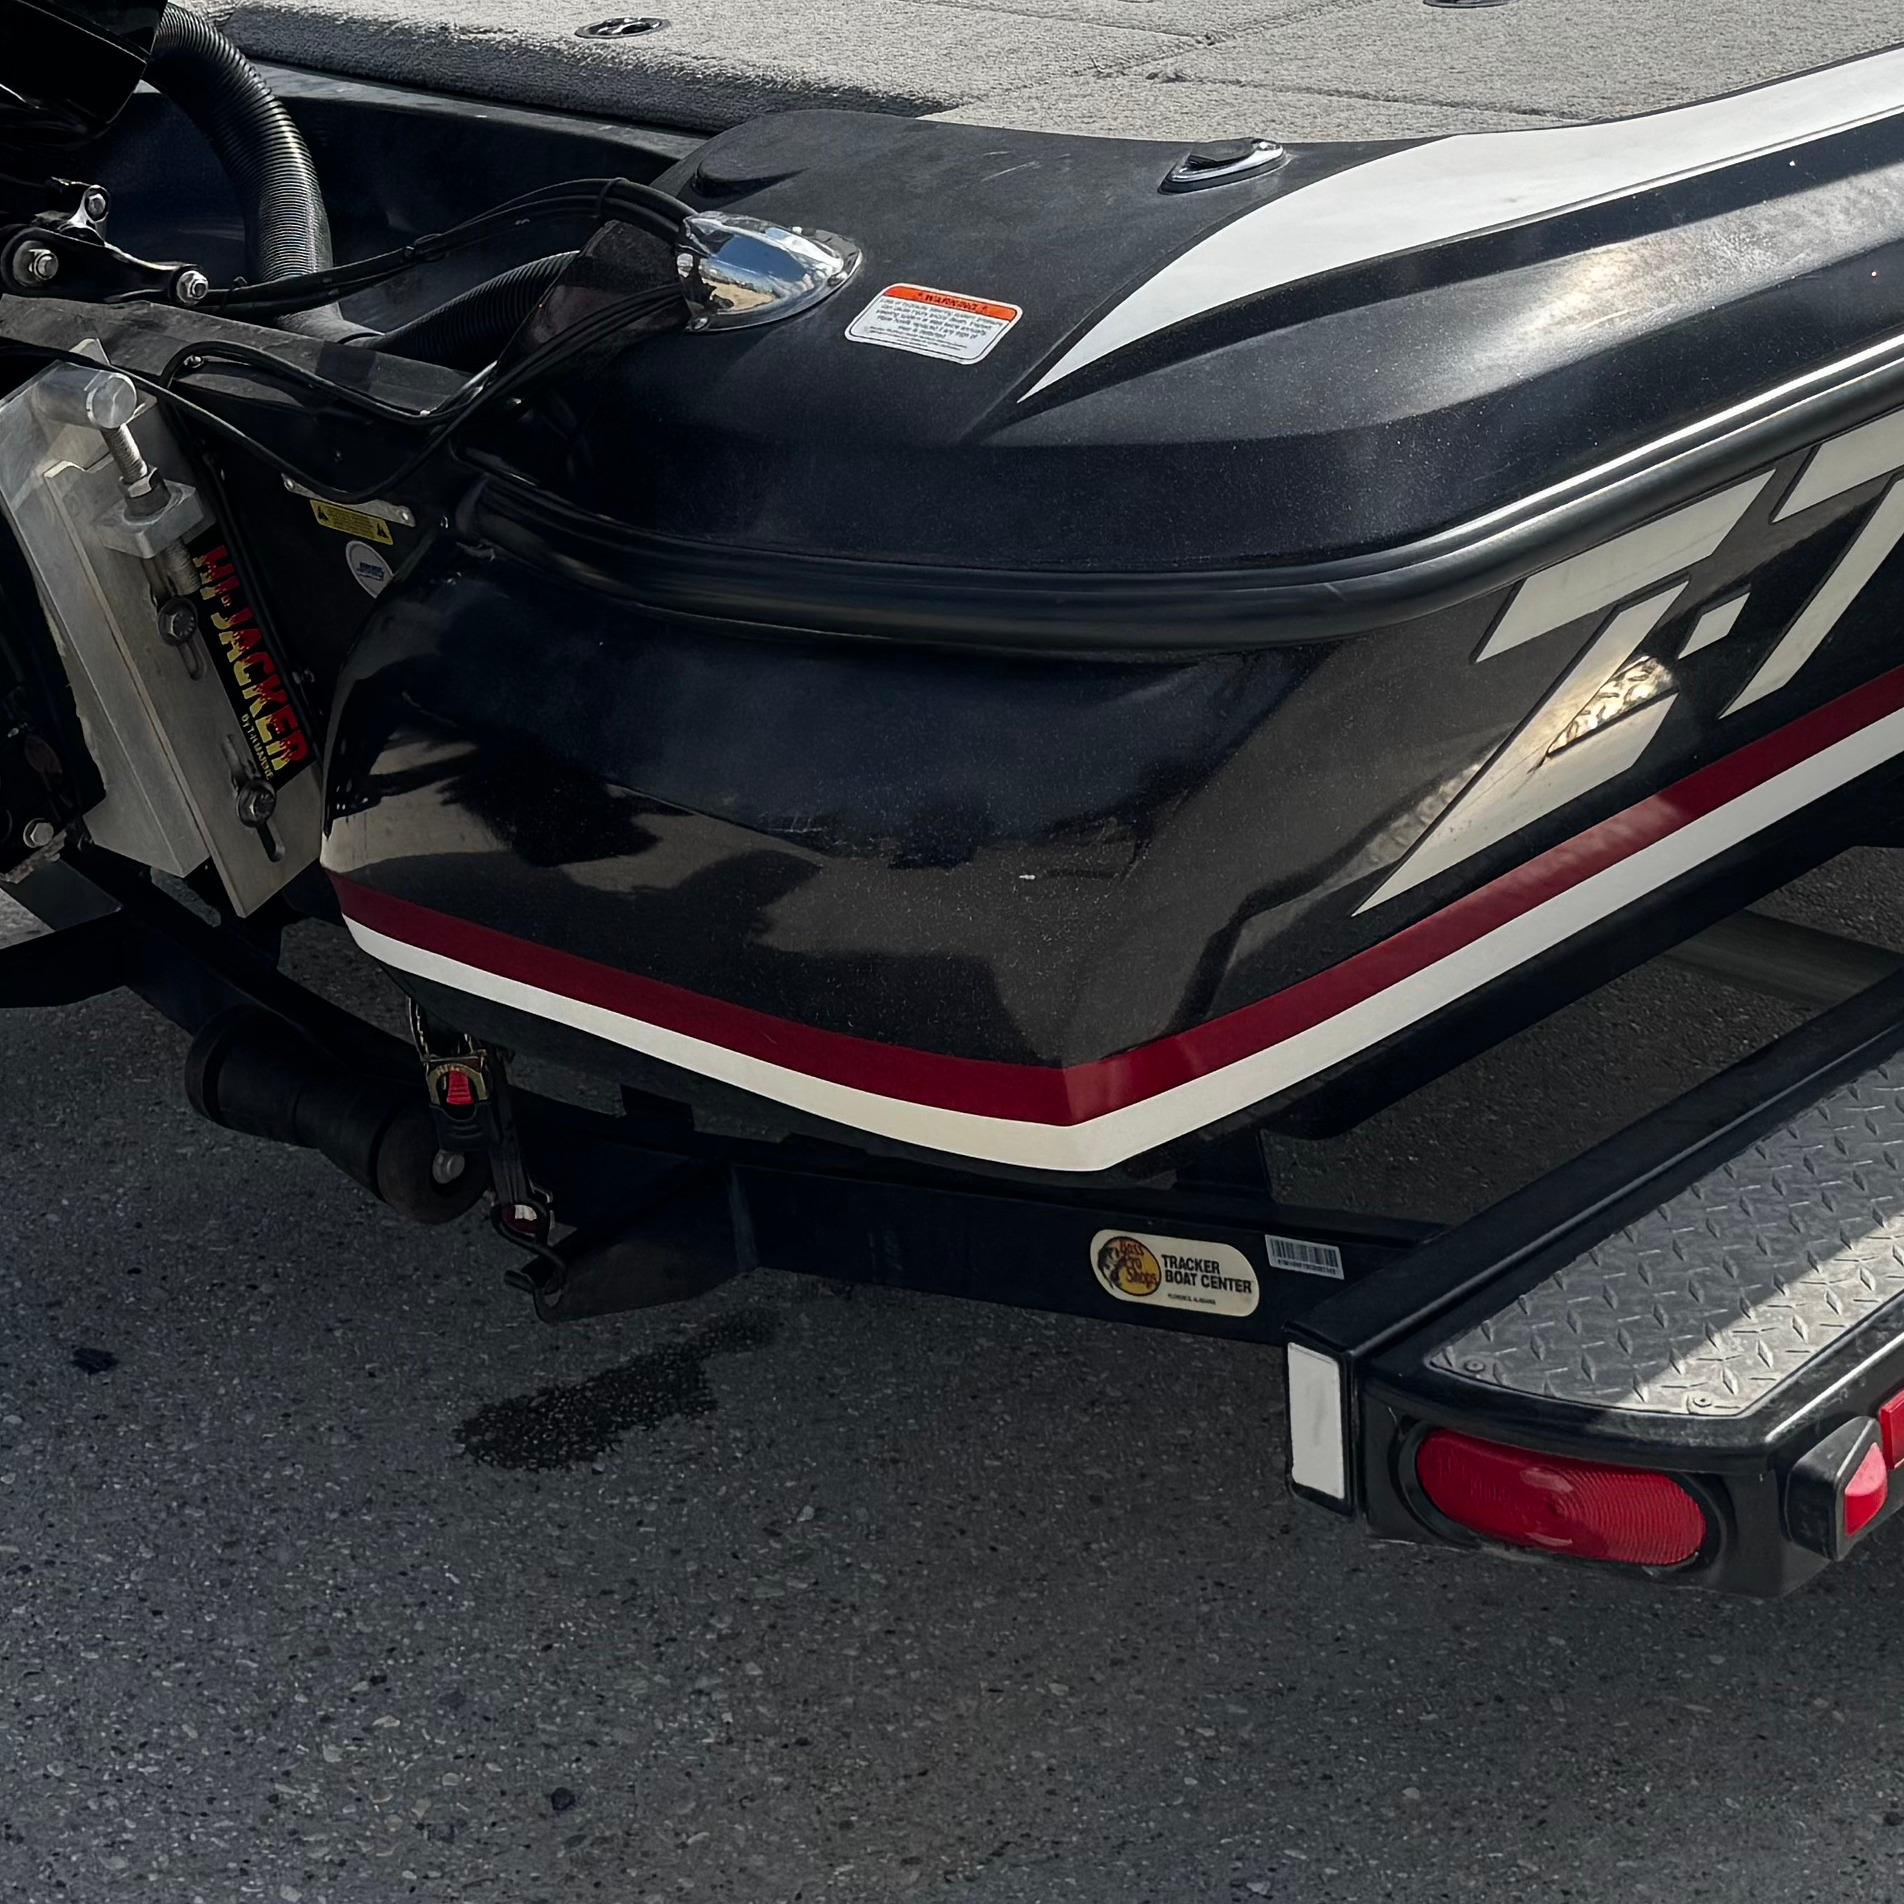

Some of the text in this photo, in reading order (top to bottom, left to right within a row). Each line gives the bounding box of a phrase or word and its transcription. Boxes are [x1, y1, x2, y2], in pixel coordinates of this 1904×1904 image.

[1161, 1254, 1221, 1275] TRACKER
[1165, 1270, 1253, 1294] BOAT CENTER
